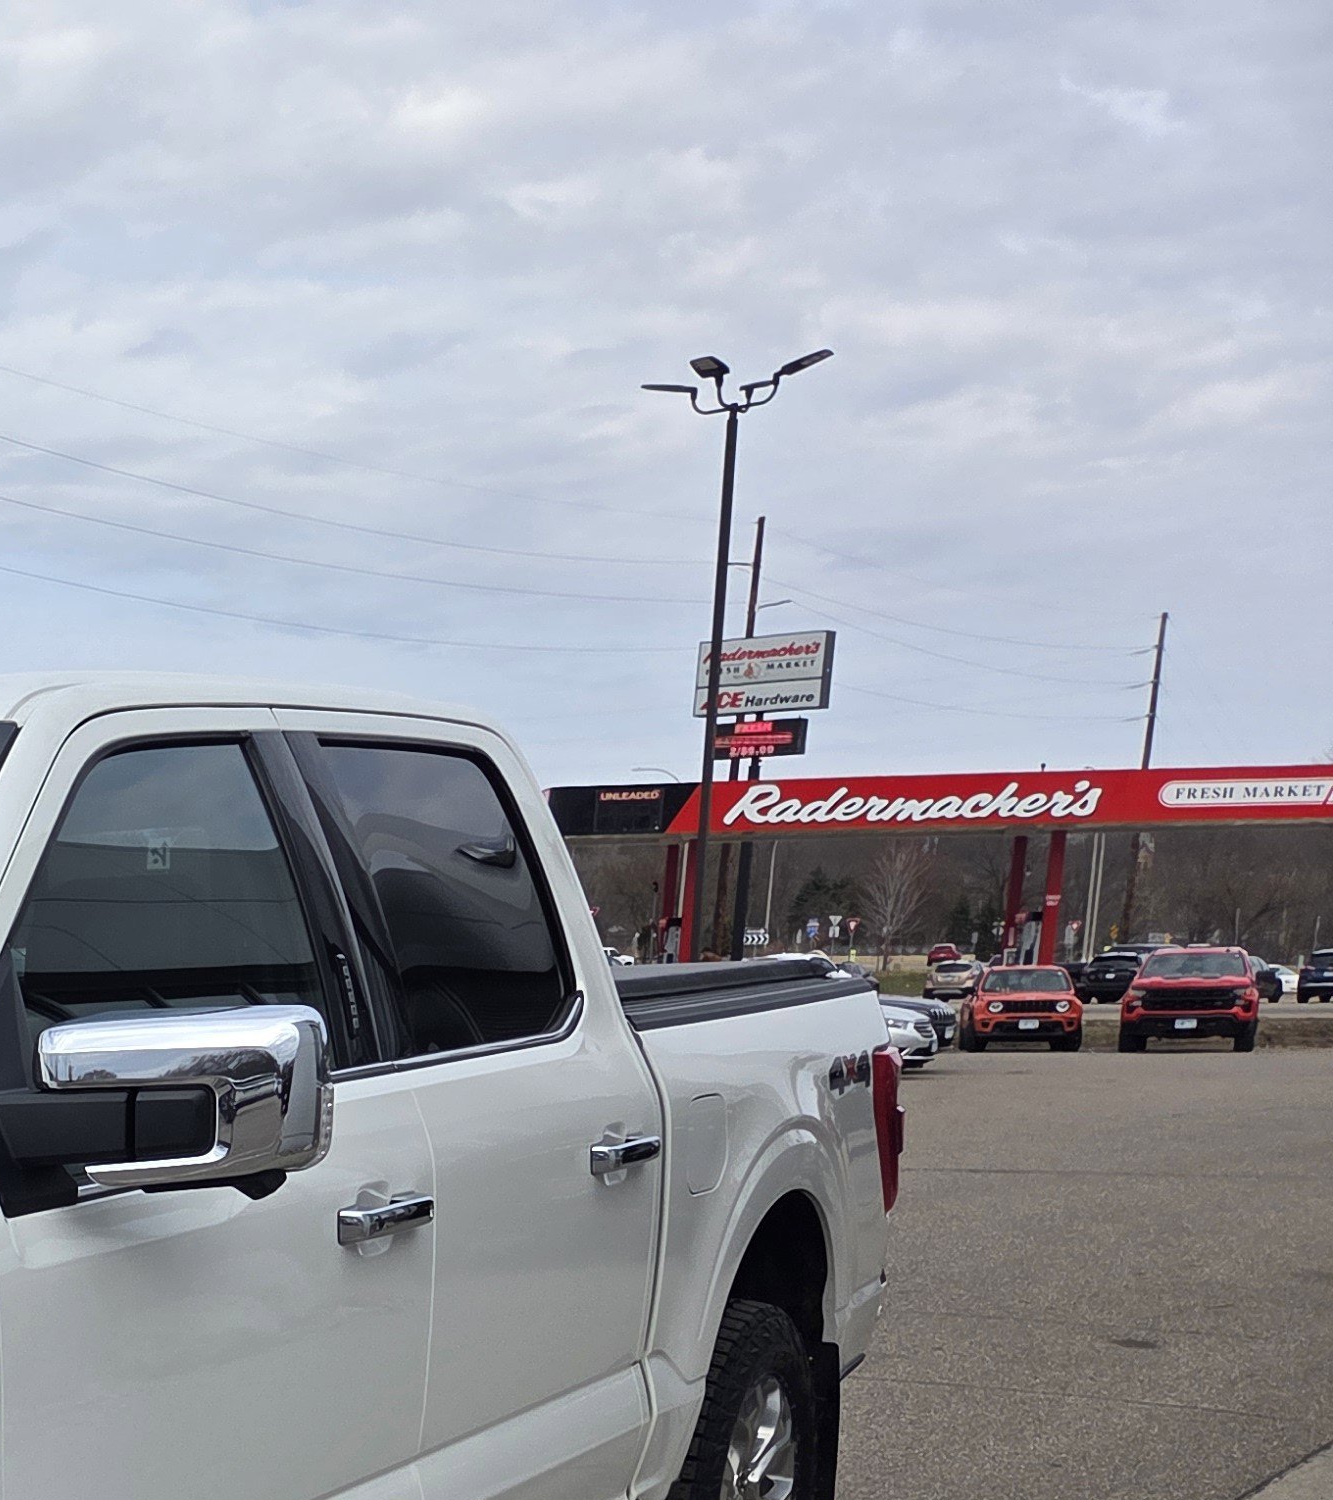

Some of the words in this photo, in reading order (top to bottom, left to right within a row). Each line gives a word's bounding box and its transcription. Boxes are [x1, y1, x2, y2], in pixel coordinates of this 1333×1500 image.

[766, 660, 816, 670] MARKET
[744, 693, 815, 708] Hardware
[600, 789, 661, 802] UNLEADED
[1175, 787, 1235, 800] FRESH
[1242, 784, 1326, 799] MARKET
[723, 779, 1103, 826] Radermacher's
